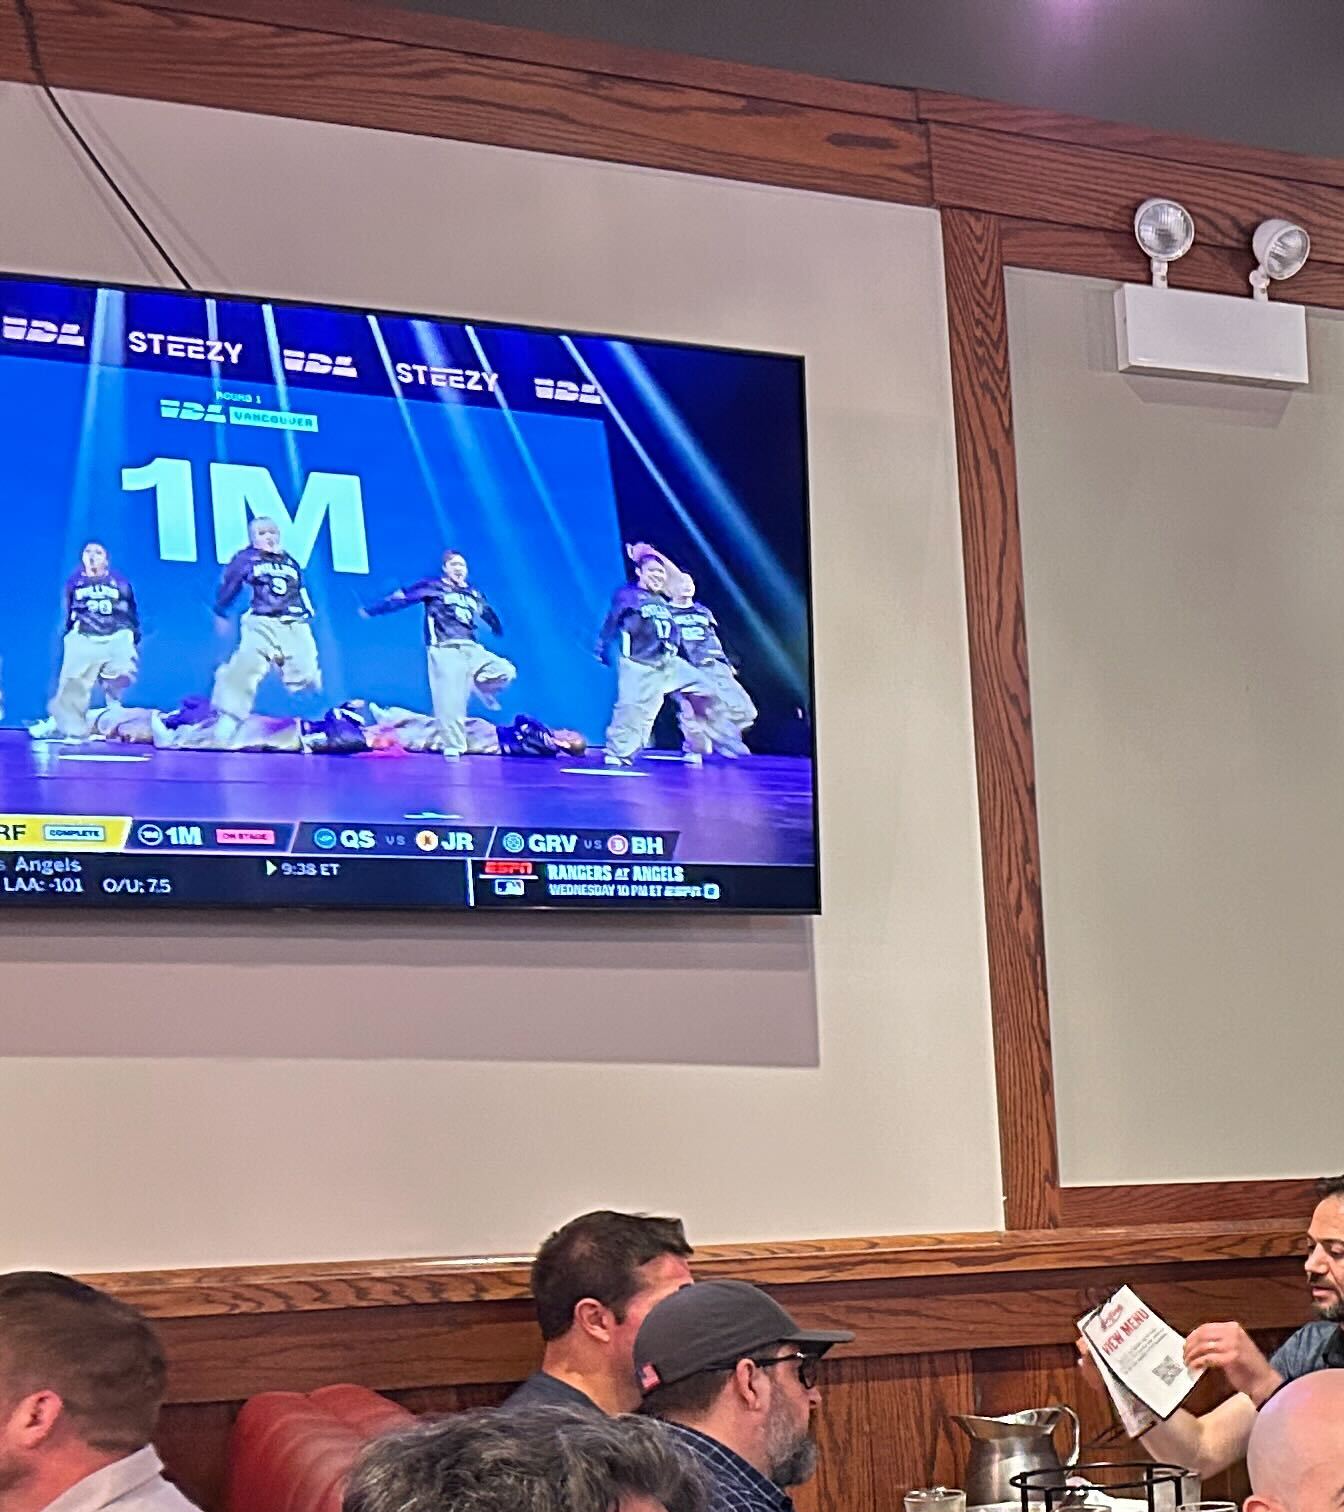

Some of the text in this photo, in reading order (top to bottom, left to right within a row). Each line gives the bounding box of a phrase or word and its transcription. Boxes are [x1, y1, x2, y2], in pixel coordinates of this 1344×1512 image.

[128, 331, 242, 364] STEEZY
[395, 362, 499, 392] STEEZY
[233, 411, 313, 428] VANCOUVER
[121, 457, 369, 574] 1M
[49, 829, 100, 838] COMPLETE
[165, 826, 203, 846] 1M
[340, 829, 376, 850] QS
[441, 831, 474, 851] JR
[528, 834, 578, 853] GRV
[631, 836, 663, 854] BH
[15, 856, 82, 875] Angels
[320, 863, 341, 876] ET
[485, 862, 532, 874] ESPN
[547, 864, 613, 881] RANGERS
[632, 866, 684, 882] ANGELS
[549, 884, 615, 897] WEDNESDAY
[1120, 1308, 1150, 1336] MENU
